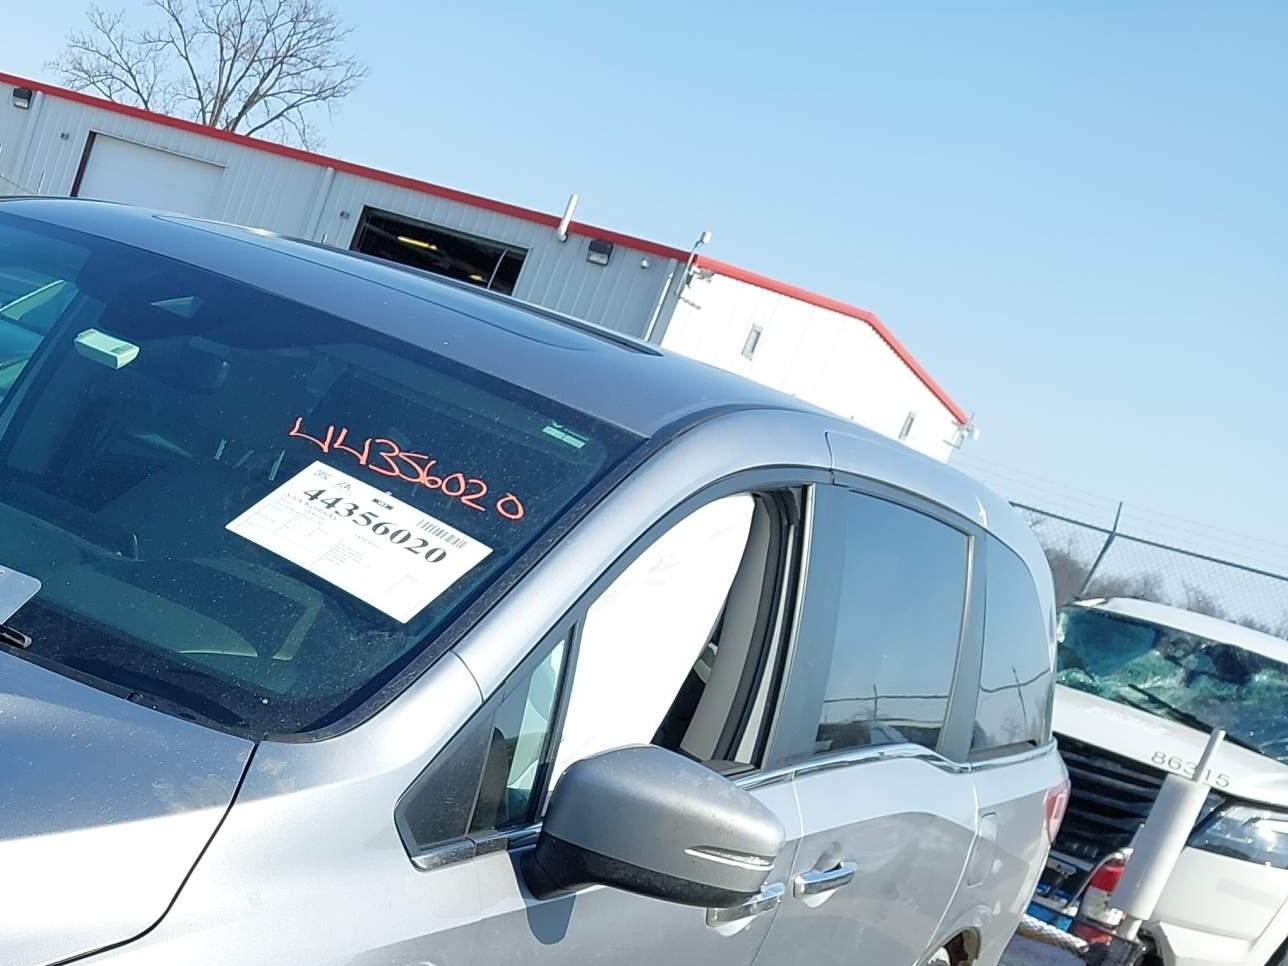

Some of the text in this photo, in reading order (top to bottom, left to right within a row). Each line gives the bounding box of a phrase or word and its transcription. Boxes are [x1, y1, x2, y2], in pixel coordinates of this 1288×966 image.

[289, 416, 525, 520] 44356020
[303, 487, 448, 564] 44356020
[1151, 751, 1230, 788] 86315
